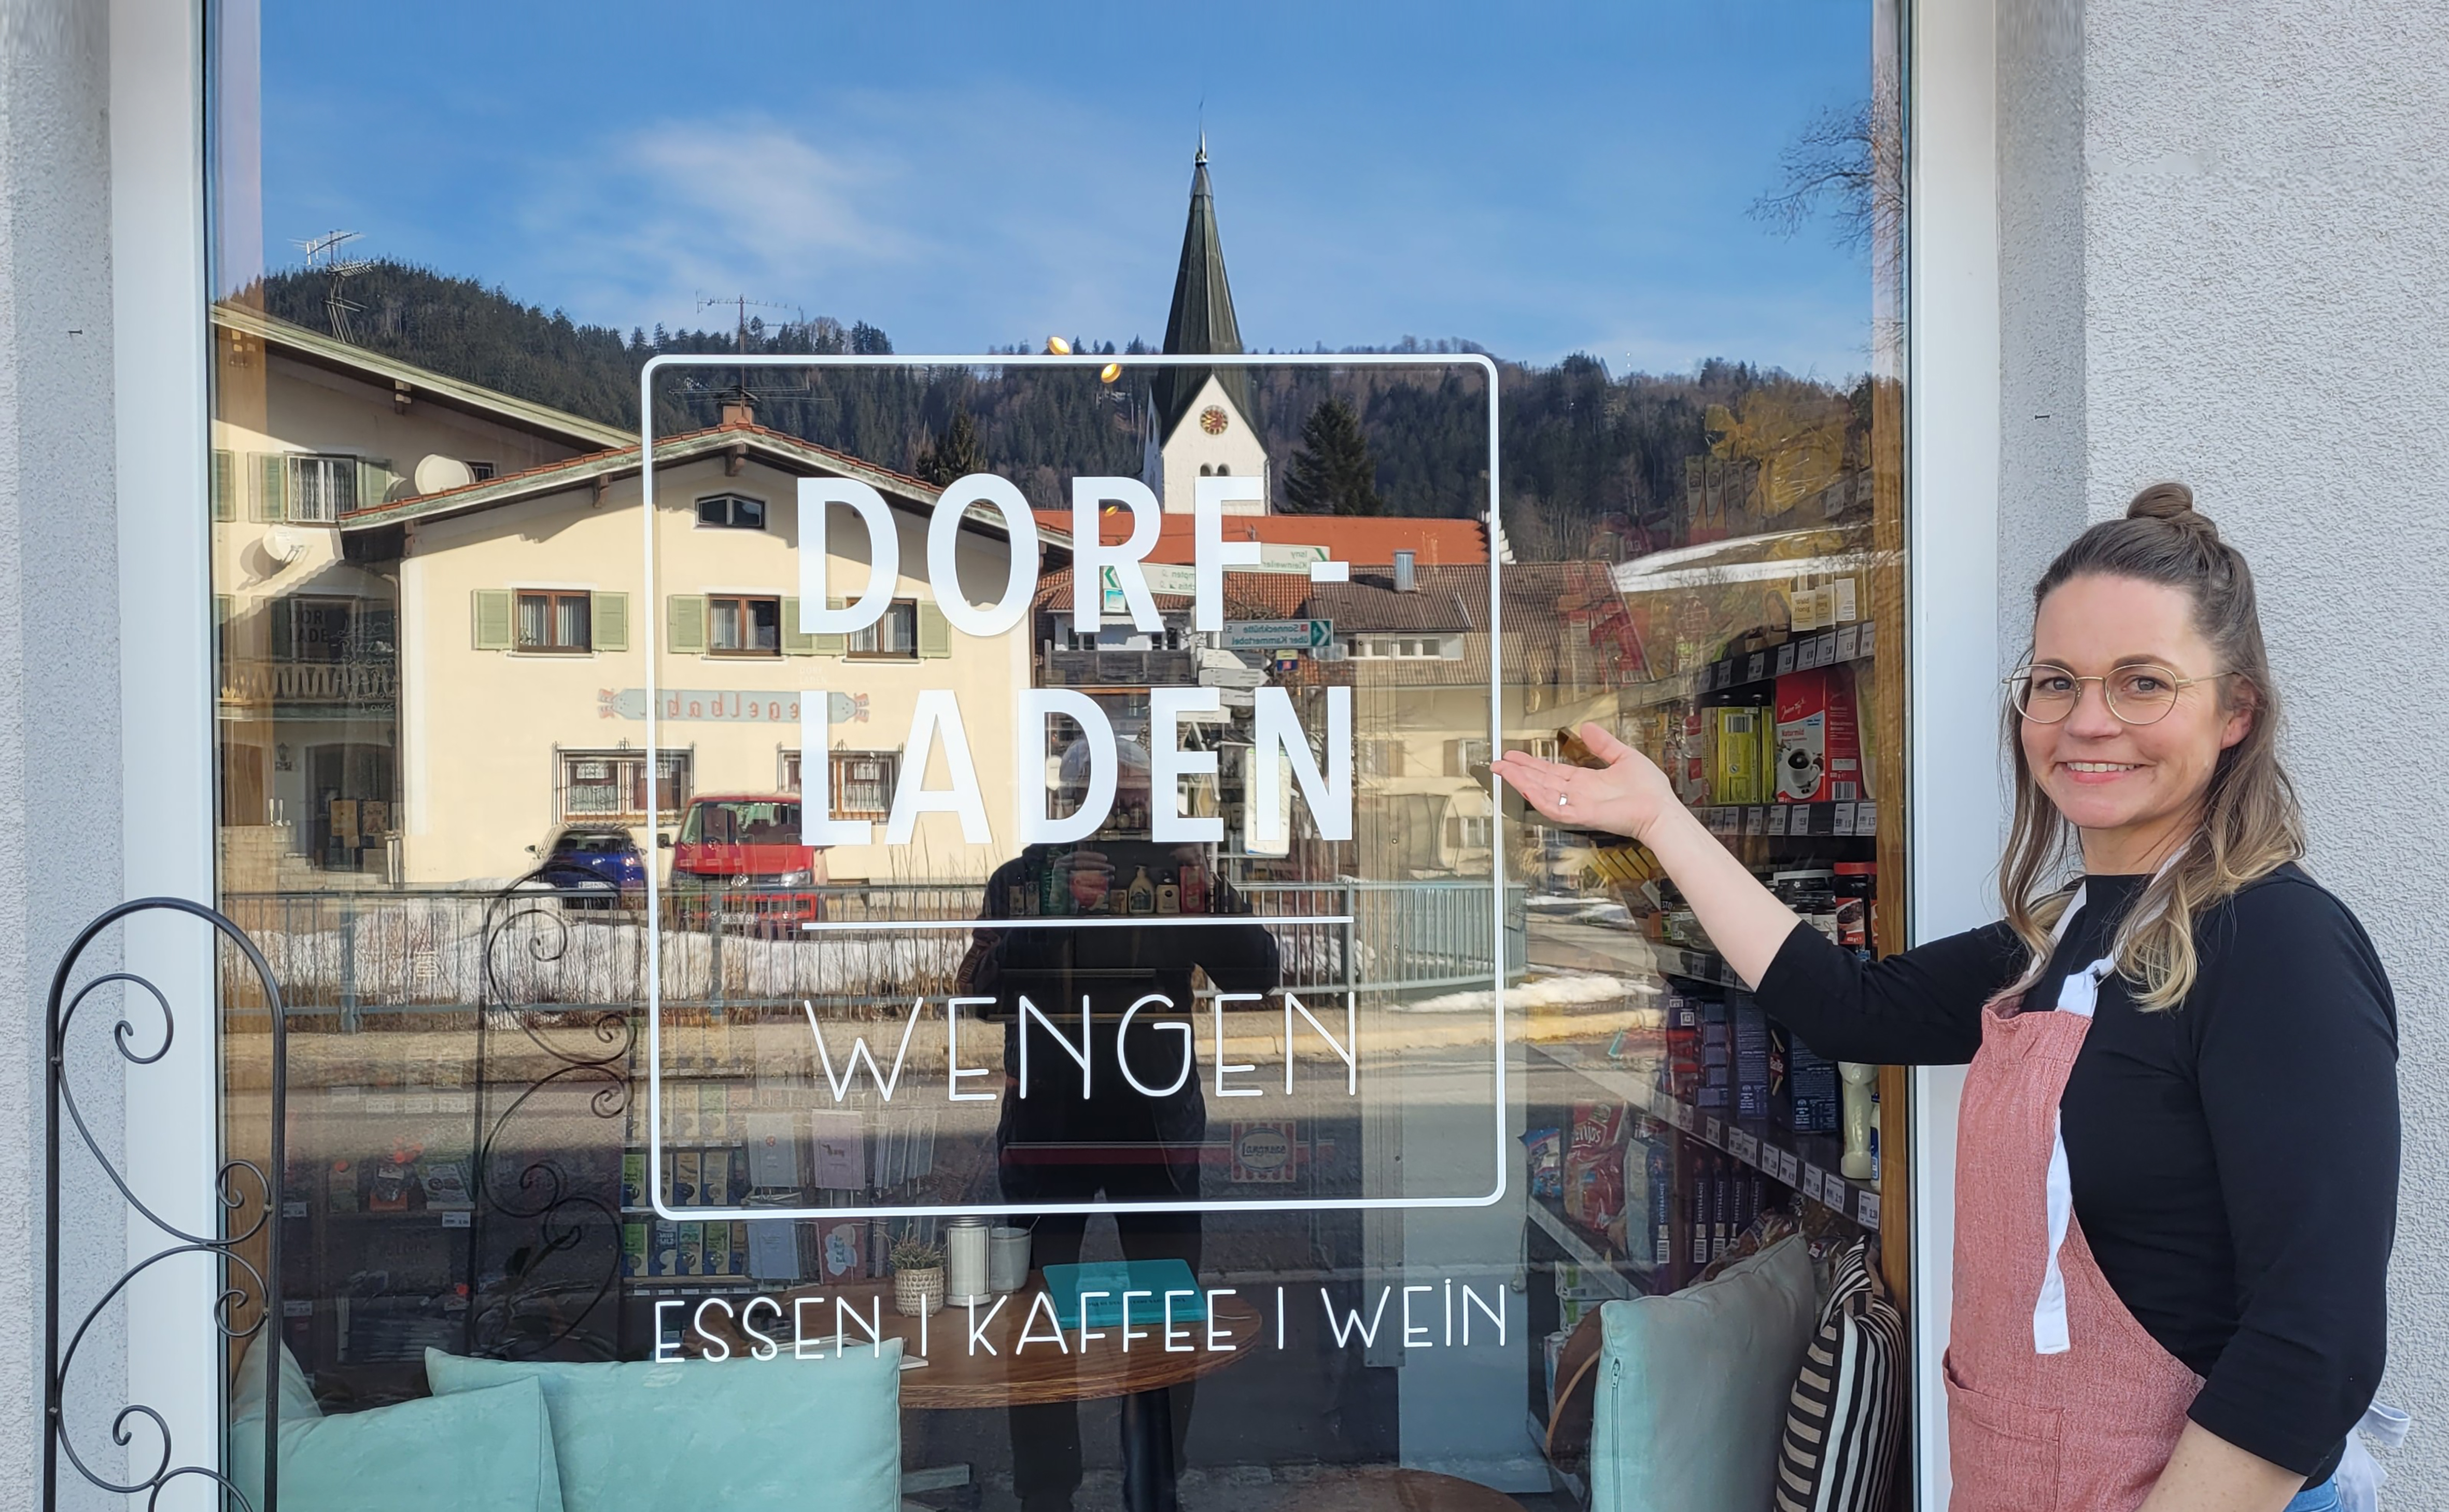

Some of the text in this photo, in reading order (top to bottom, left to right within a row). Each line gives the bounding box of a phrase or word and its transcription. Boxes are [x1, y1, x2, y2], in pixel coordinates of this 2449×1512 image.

[797, 473, 1349, 638] DORF-
[800, 685, 1353, 846] LADEN
[804, 991, 1356, 1102] WENGEN
[1242, 1142, 1287, 1157] Langnese
[654, 1294, 881, 1364] ESSEN
[968, 1289, 1237, 1356] KAFFEE
